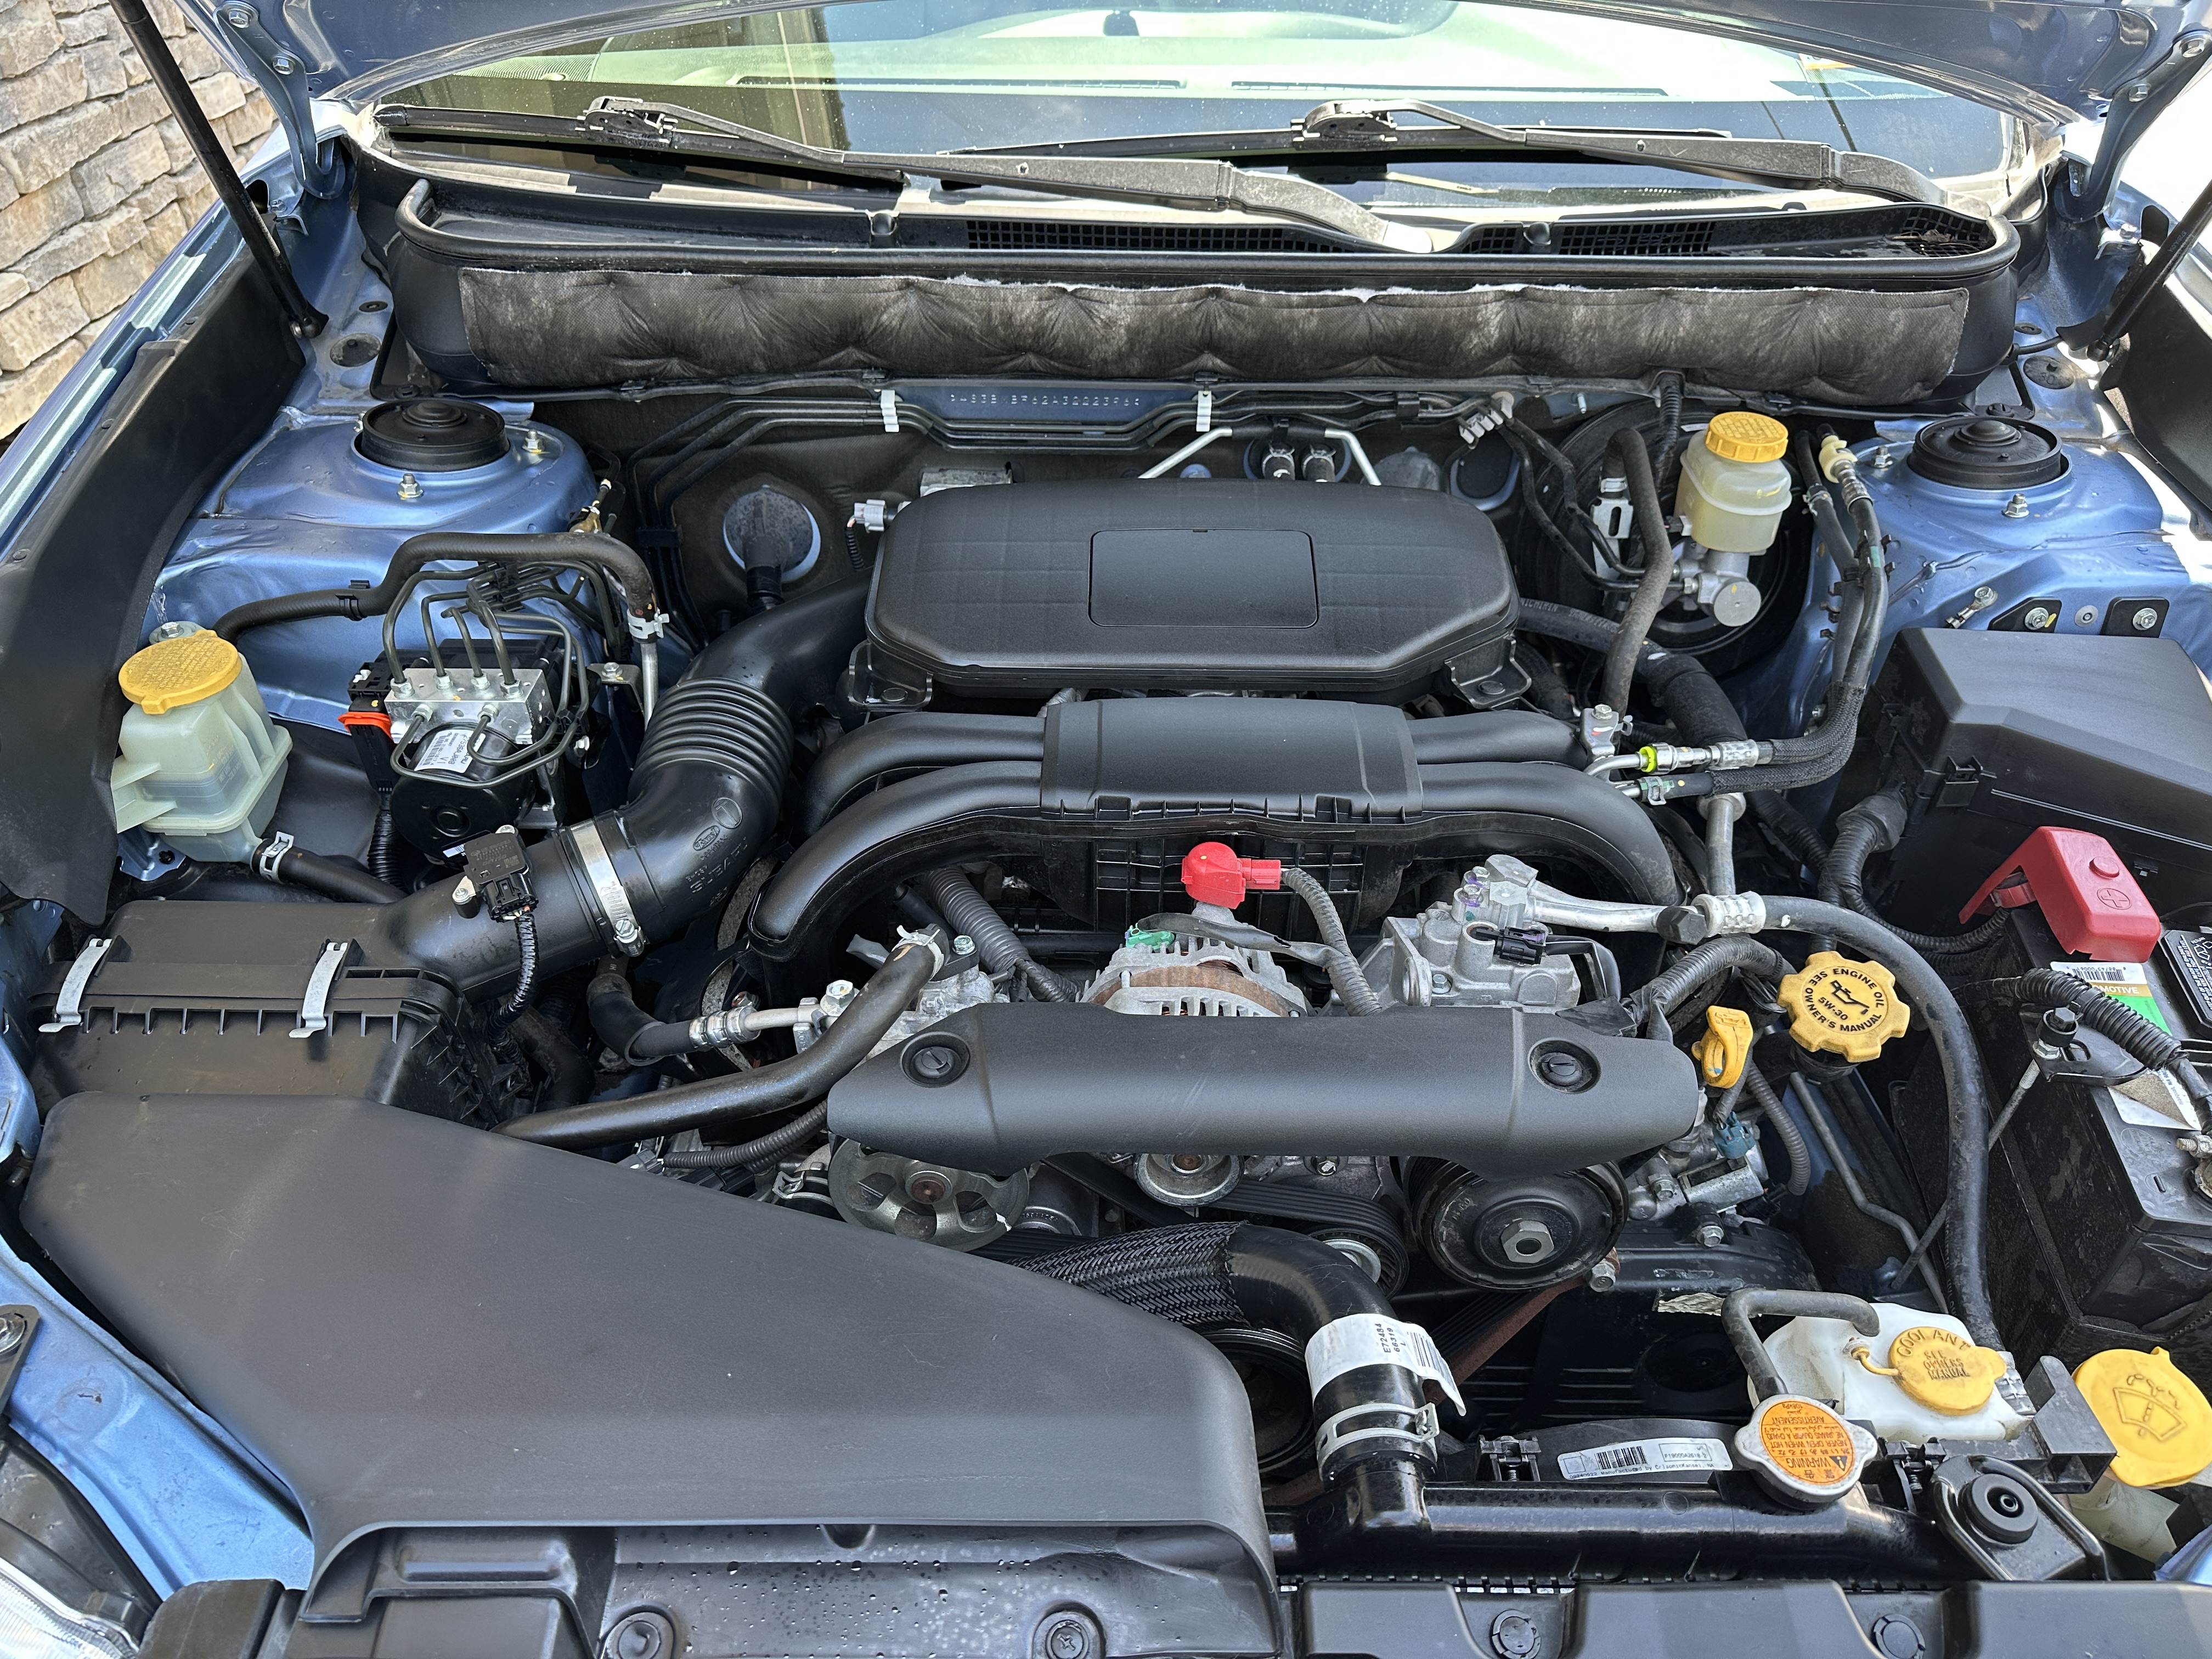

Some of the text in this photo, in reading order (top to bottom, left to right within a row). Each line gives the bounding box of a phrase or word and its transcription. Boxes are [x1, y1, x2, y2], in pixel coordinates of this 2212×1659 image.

[1833, 968, 1884, 1008] ENGINE OIL
[1805, 971, 1882, 1032] SEE OWNER'S MANUAL
[1818, 997, 1848, 1020] 5W-30
[1374, 1323, 1391, 1353] E72484
[1387, 1328, 1400, 1352] 66319
[1927, 1367, 1971, 1380] MANUAL
[1601, 1466, 1643, 1476] Manufactured
[1786, 1457, 1831, 1468] WARNING
